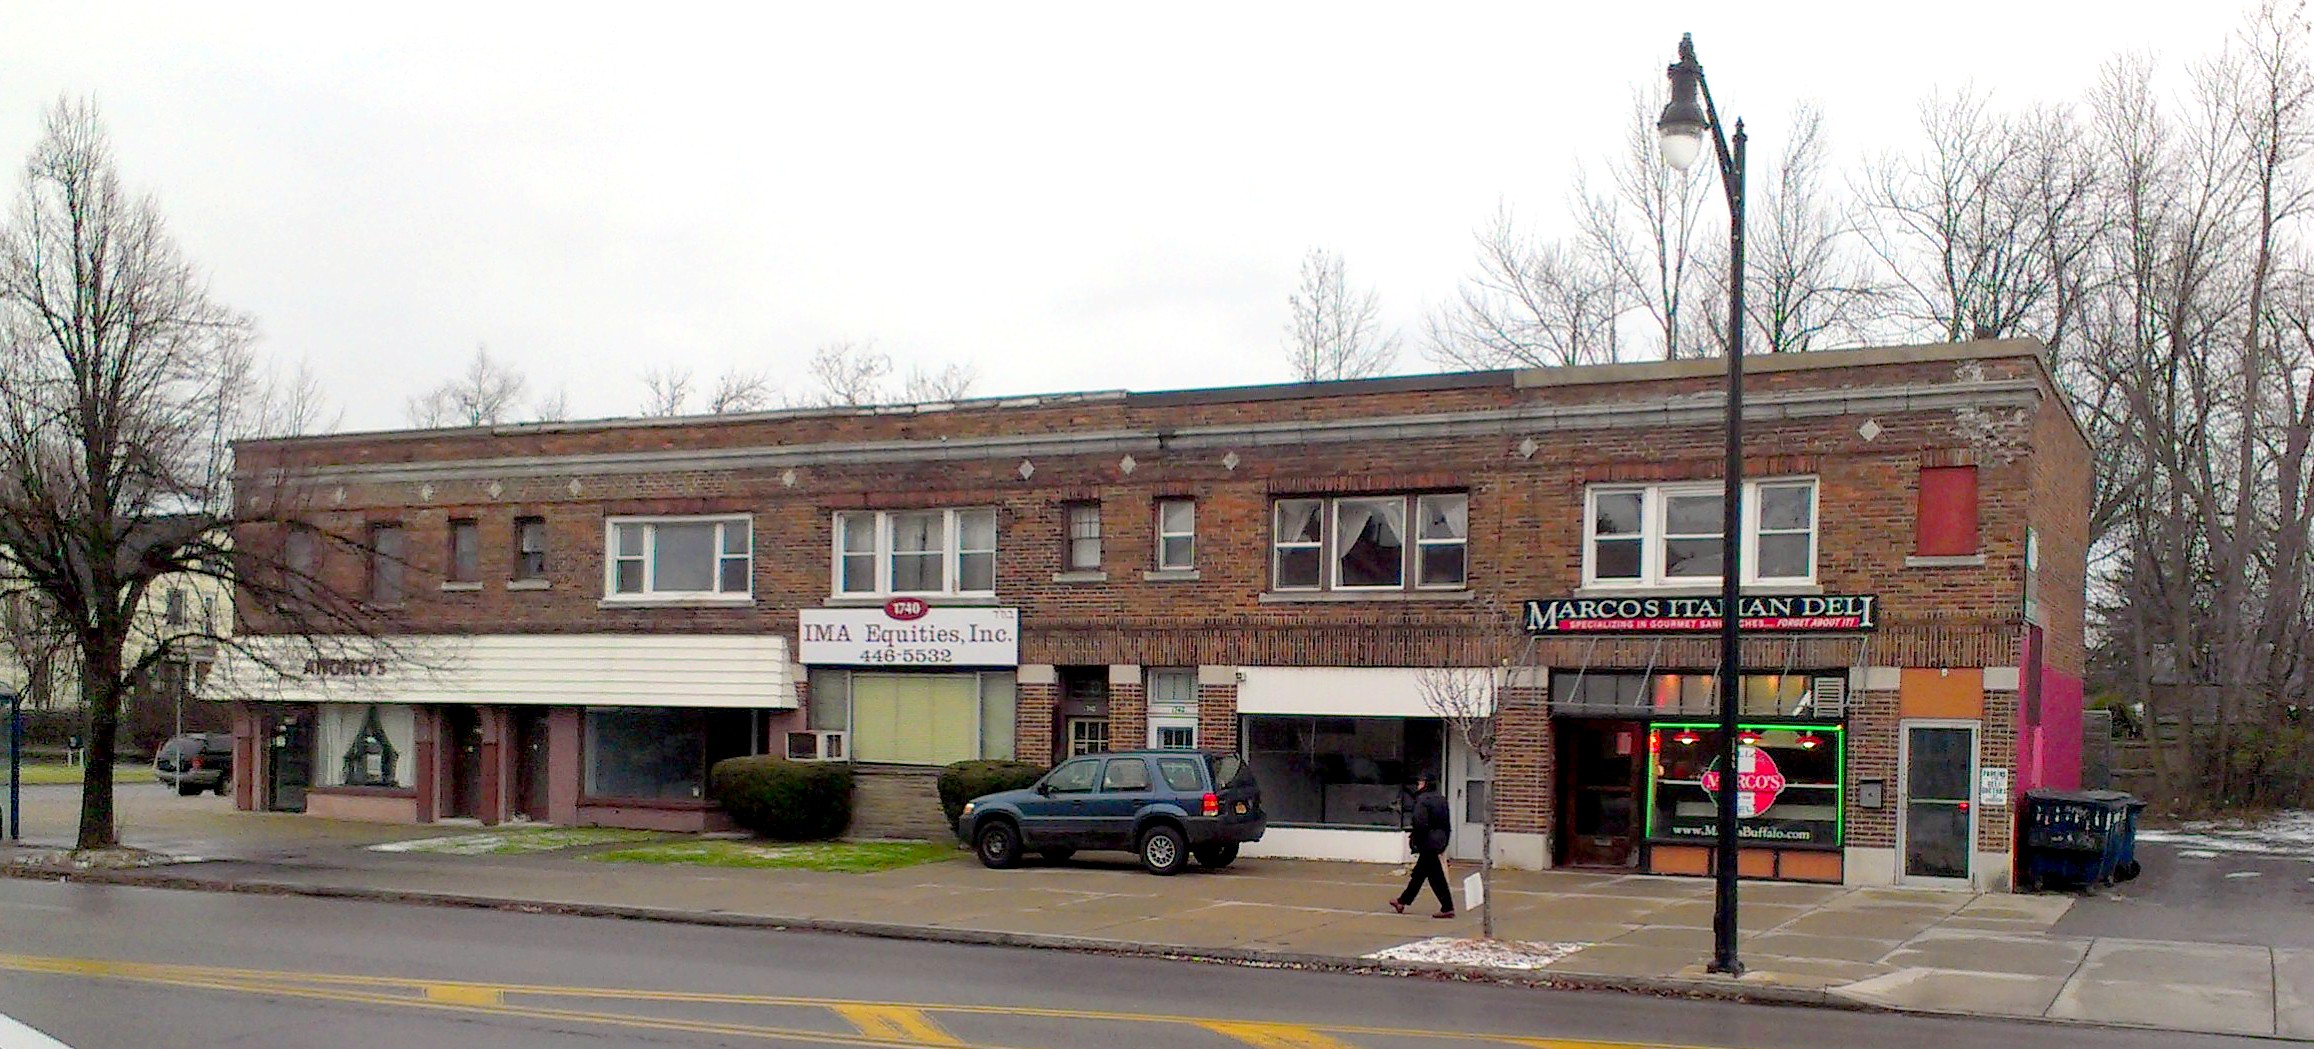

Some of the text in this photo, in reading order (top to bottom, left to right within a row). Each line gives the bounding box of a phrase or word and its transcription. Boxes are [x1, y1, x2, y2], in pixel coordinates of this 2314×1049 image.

[892, 601, 921, 615] 1740
[1802, 596, 1875, 628] DELI
[1569, 619, 1635, 630] SPECIALIZING
[1636, 619, 1648, 629] IN
[1650, 618, 1697, 629] GOURMET
[1777, 617, 1810, 628] FORGET
[1811, 616, 1841, 628] ABOUT
[803, 623, 1013, 648] IMA Equities, Inc.
[859, 648, 953, 664] 446-5532
[1707, 774, 1781, 790] MRCO'S
